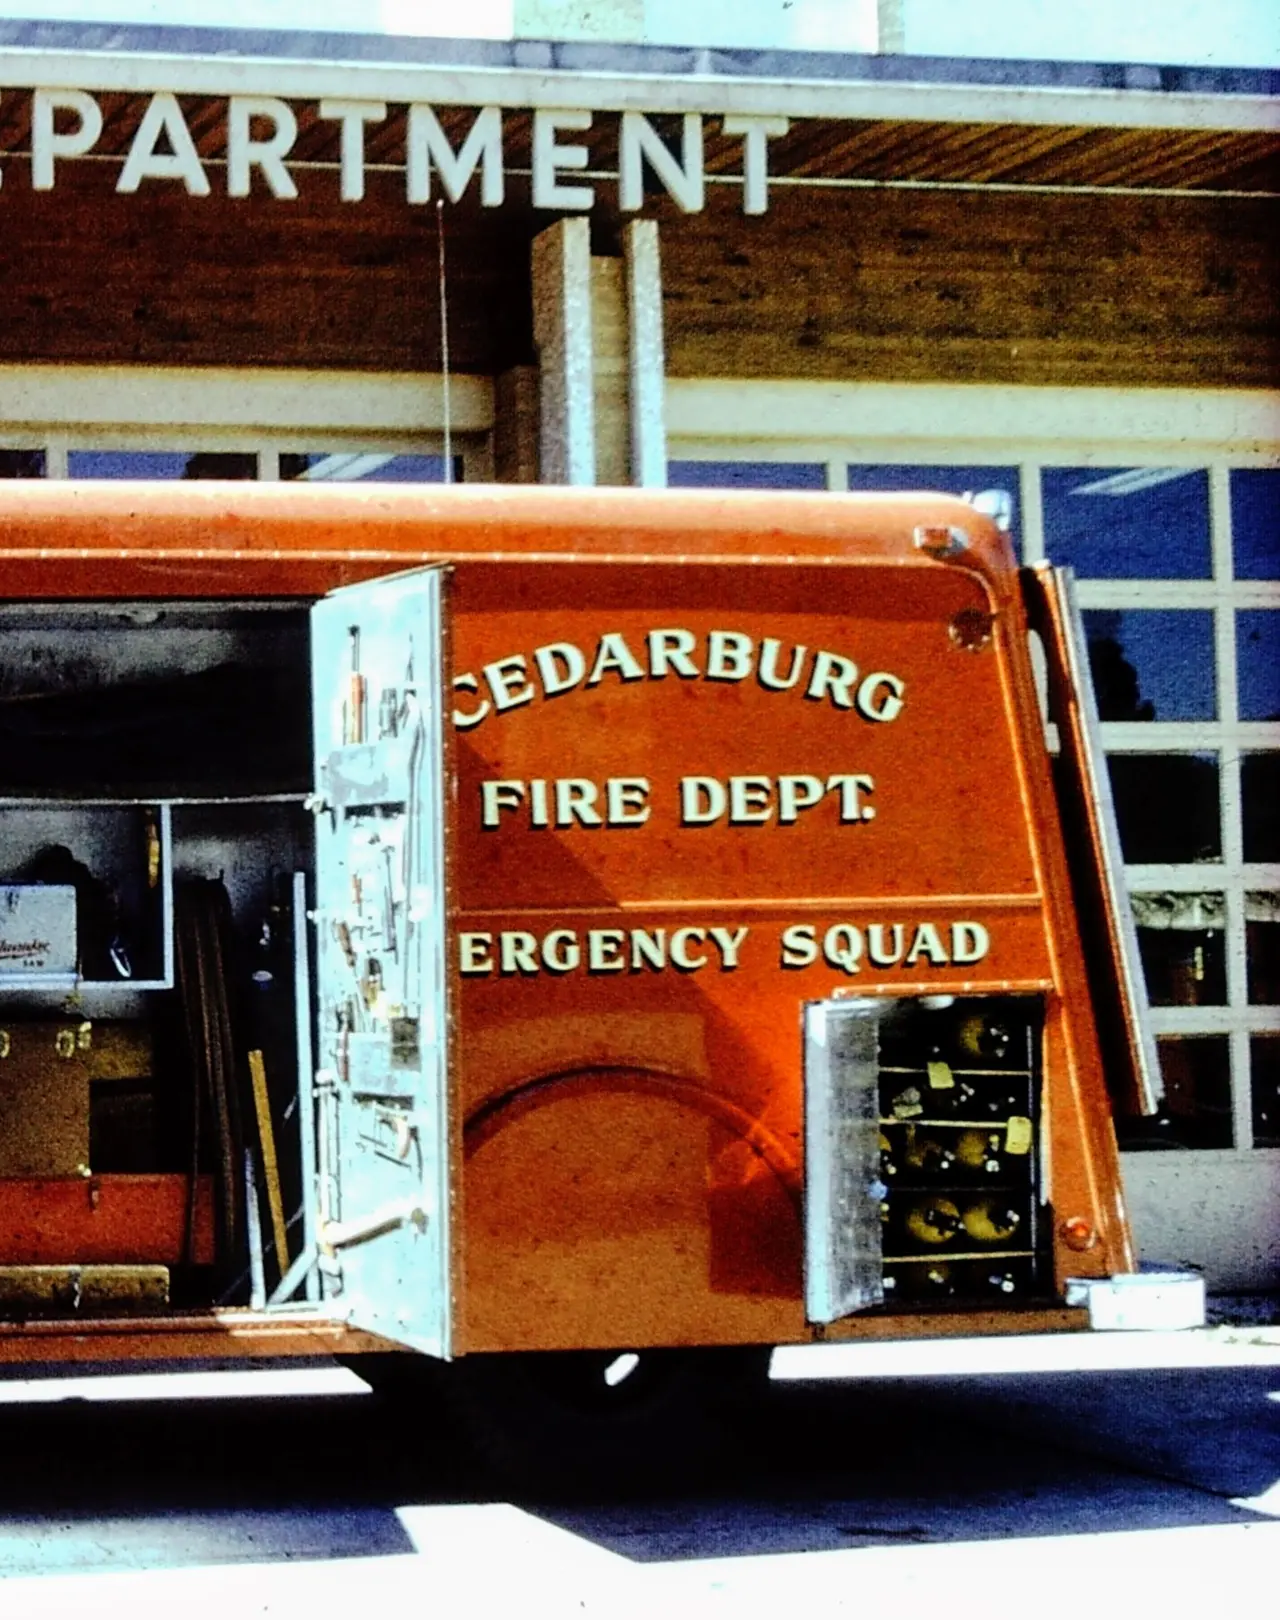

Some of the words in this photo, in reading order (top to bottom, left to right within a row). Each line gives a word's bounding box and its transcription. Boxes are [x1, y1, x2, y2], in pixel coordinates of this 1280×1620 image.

[482, 777, 652, 827] FIRE
[681, 773, 878, 825] DEPT.
[781, 921, 990, 973] SQUAD
